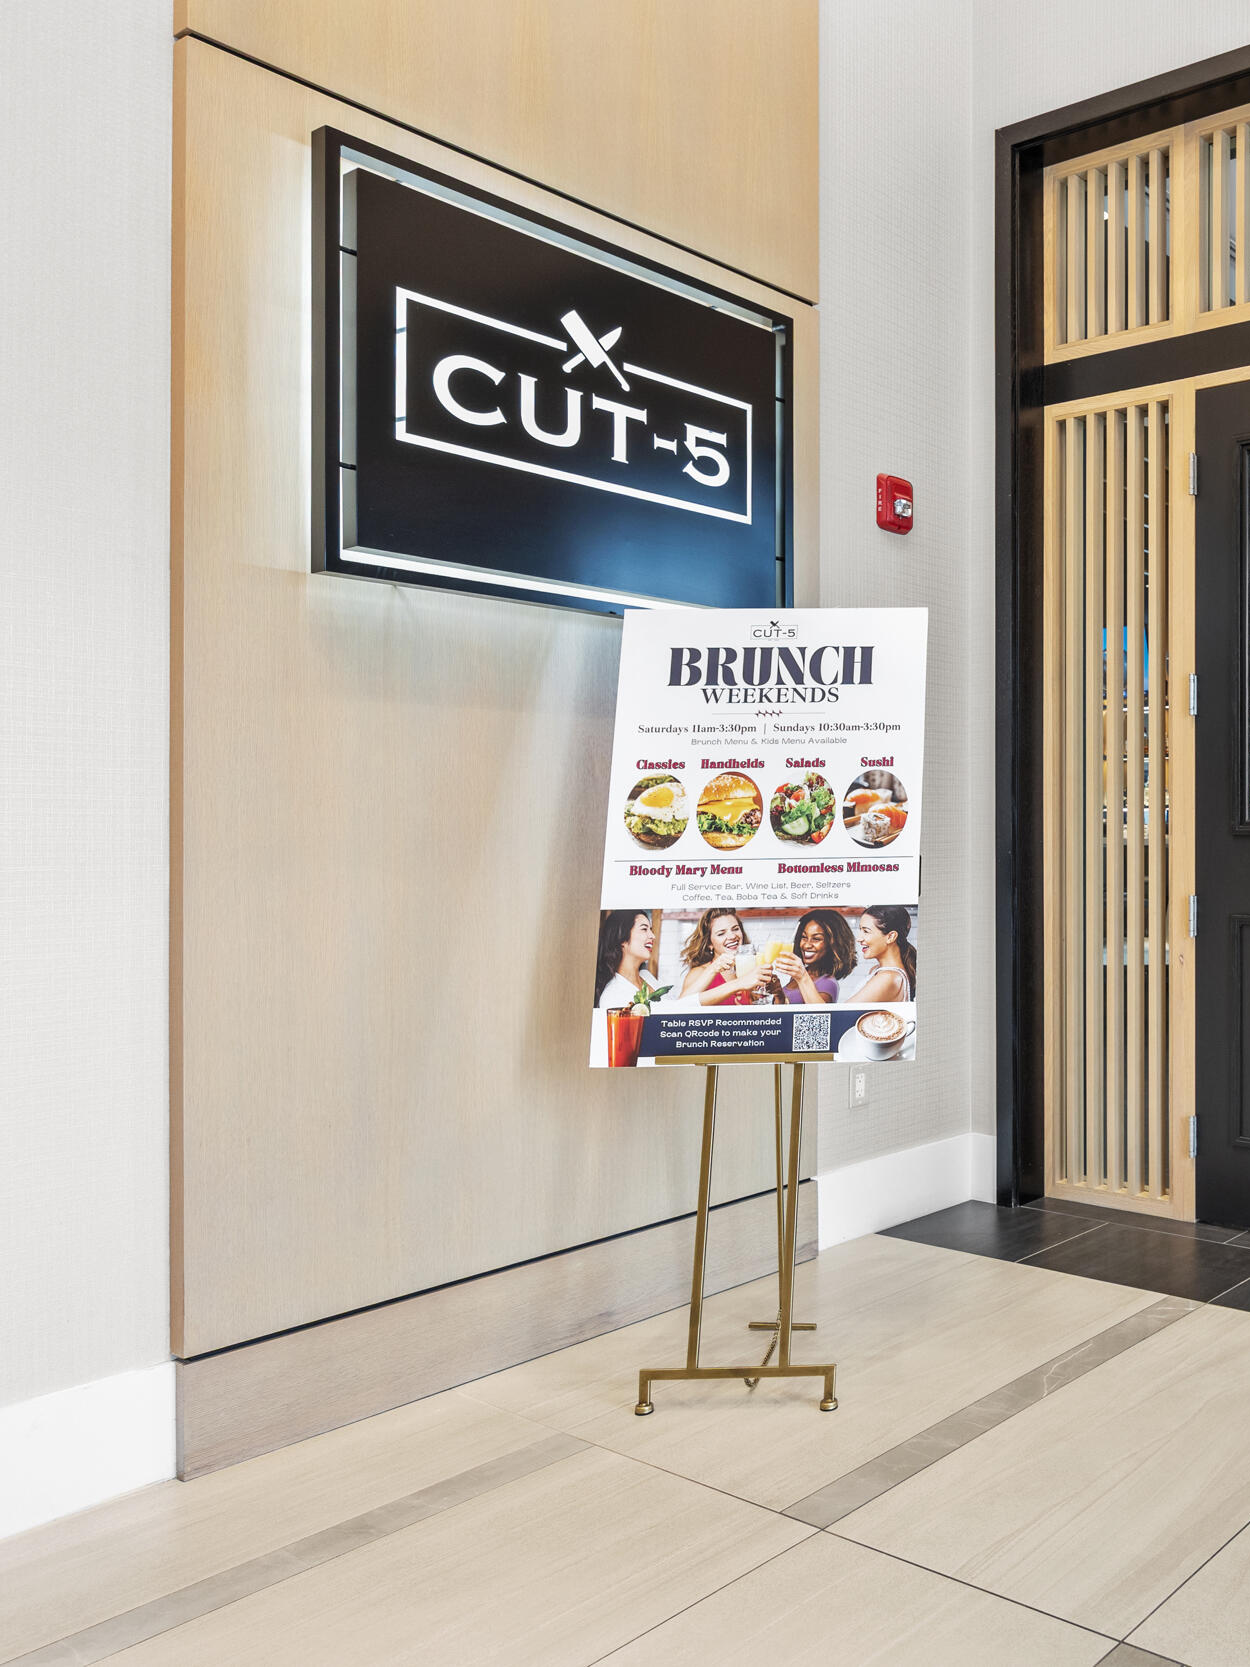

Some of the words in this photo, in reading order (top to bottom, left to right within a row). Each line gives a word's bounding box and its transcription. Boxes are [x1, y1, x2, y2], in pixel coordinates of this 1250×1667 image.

[432, 353, 731, 488] CUT-5
[753, 629, 795, 637] CUT-5
[668, 646, 875, 687] BRUNCH
[702, 687, 839, 704] WEEKENDS
[638, 724, 688, 734] Saturdays
[692, 723, 757, 734] 11am-3:30pm
[773, 723, 815, 733] Sundays
[818, 722, 901, 732] 10:30am-3:30pm
[636, 760, 686, 770] Classics
[701, 759, 765, 769] Handhelds
[785, 758, 826, 768] Salads
[860, 757, 894, 767] Sushi
[629, 865, 673, 878] Bloody
[676, 865, 708, 877] Mary
[710, 865, 743, 874] Menu
[777, 863, 844, 874] Bottomless
[846, 862, 899, 872] Mimosas
[816, 881, 851, 889] Seltzers
[661, 1020, 686, 1028] Table
[716, 1018, 782, 1026] Recommended
[760, 1029, 782, 1037] your
[676, 1040, 708, 1048] Brunch
